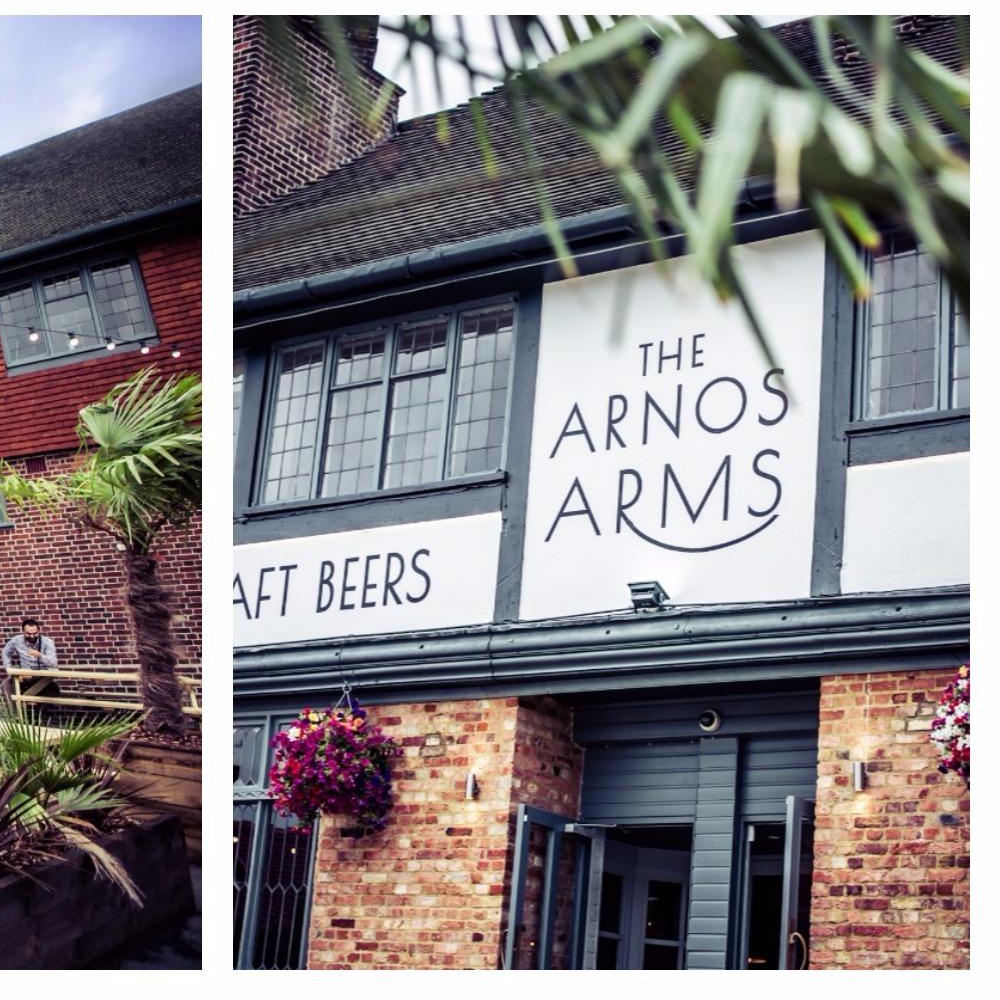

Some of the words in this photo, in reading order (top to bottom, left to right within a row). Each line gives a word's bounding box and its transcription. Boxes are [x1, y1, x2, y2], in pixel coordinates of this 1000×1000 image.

[638, 333, 707, 377] THE
[549, 368, 790, 459] ARNOS
[544, 448, 783, 554] ARMS
[315, 548, 432, 614] BEERS
